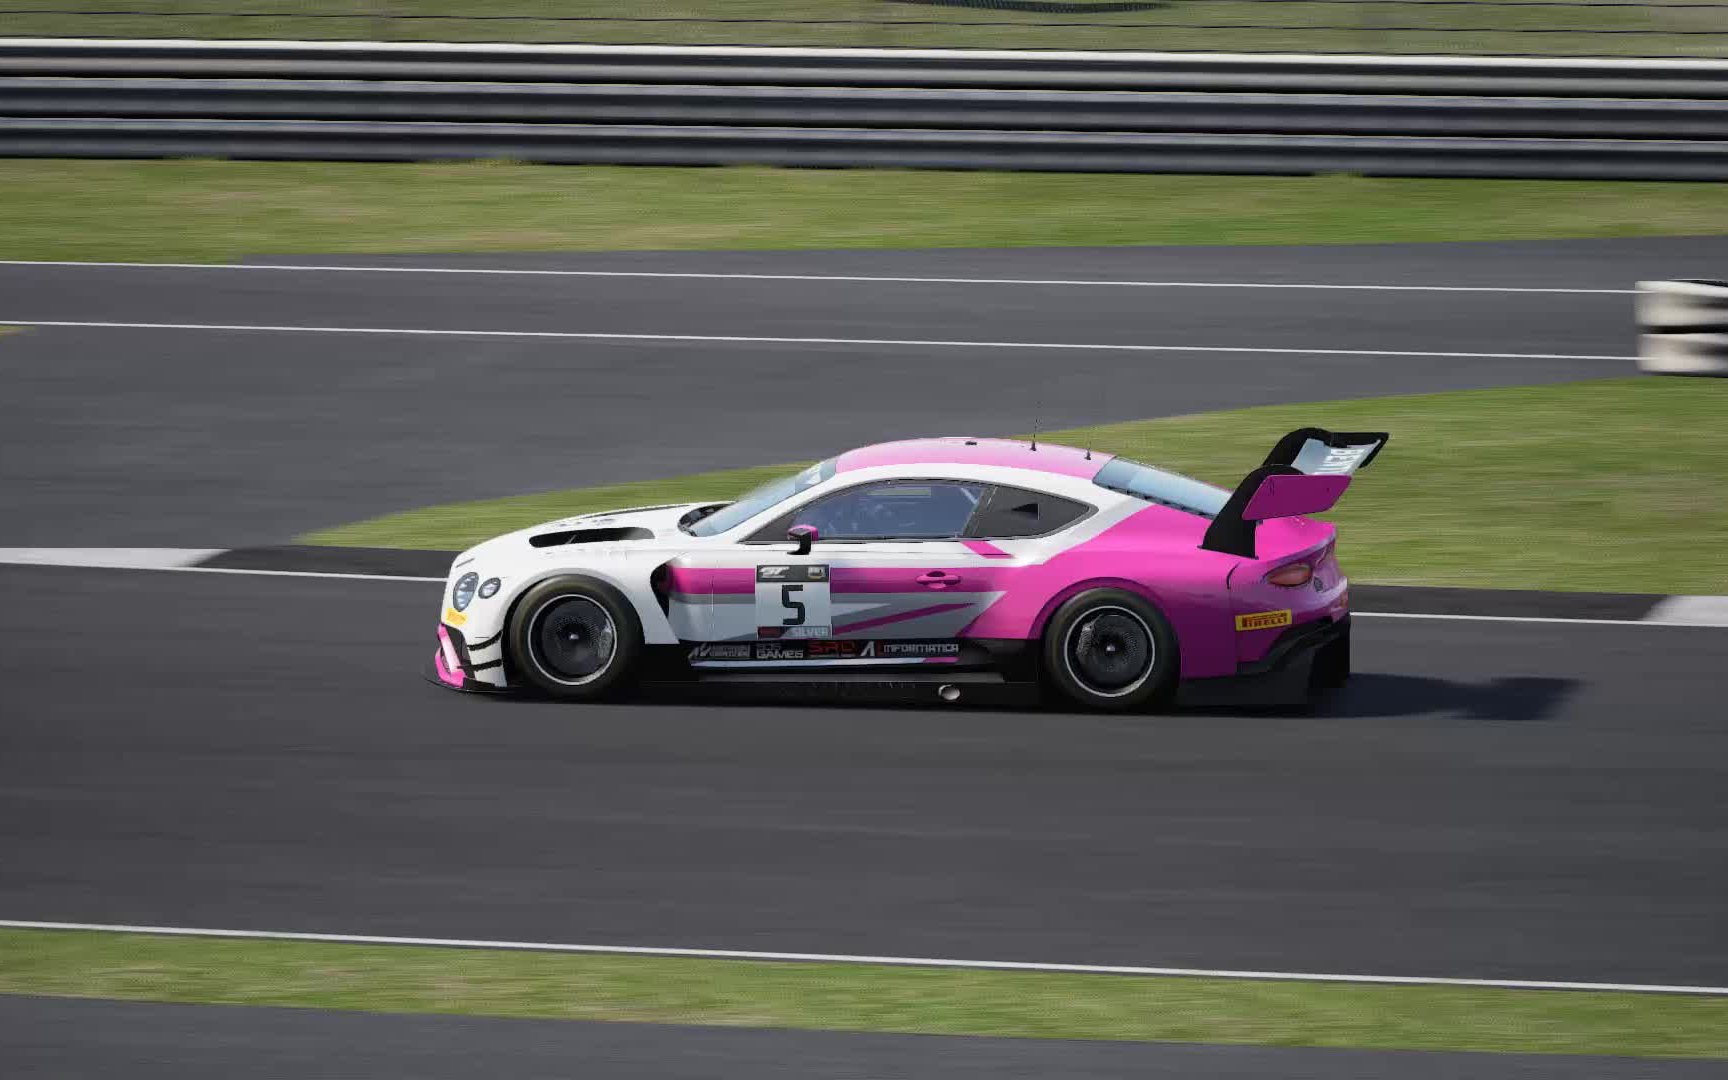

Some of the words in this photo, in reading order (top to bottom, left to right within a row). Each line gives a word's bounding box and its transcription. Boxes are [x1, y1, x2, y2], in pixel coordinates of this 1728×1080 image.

[782, 585, 805, 625] 5
[1242, 612, 1287, 627] PIRELLI
[789, 628, 829, 638] SILVER
[757, 649, 804, 659] GAMES
